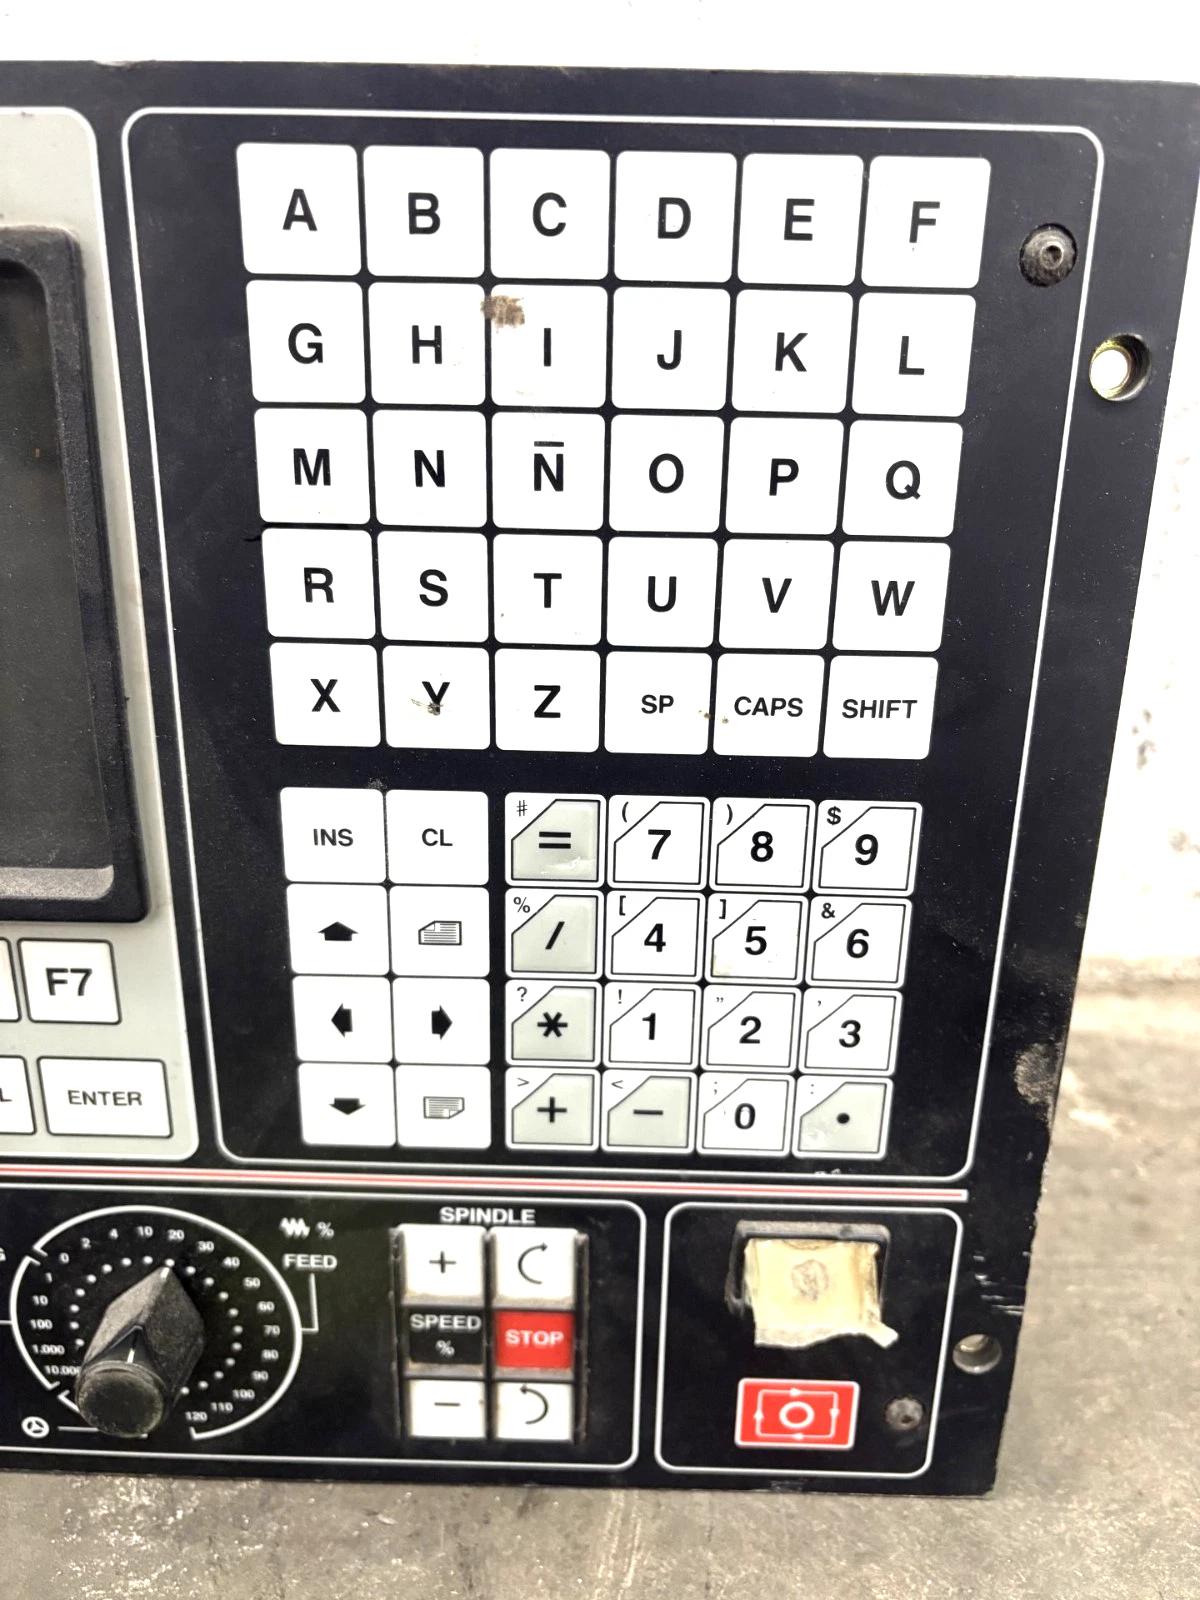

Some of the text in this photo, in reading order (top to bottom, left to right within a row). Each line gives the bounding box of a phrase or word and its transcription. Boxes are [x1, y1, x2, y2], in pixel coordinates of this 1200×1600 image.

[282, 189, 318, 231] A
[409, 192, 441, 235] B
[532, 192, 568, 237] C
[658, 198, 691, 239] D
[784, 199, 814, 241] E
[909, 202, 940, 243] F
[288, 323, 324, 364] G
[412, 326, 442, 364] H
[544, 329, 551, 366] I
[657, 330, 682, 370] J
[776, 333, 807, 372] K
[899, 337, 924, 375] L
[293, 449, 331, 486] M
[415, 450, 445, 488] N
[649, 454, 684, 494] O
[770, 459, 799, 496] P
[886, 461, 921, 499] Q
[304, 568, 334, 602] R
[419, 570, 448, 606] S
[534, 573, 561, 608] T
[648, 576, 677, 612] U
[762, 579, 792, 614] V
[872, 581, 914, 616] W
[311, 680, 340, 712] X
[423, 682, 451, 715] Y
[534, 685, 561, 718] Z
[641, 694, 674, 713] SP
[734, 696, 803, 718] CAPS
[842, 699, 918, 719] SHIFT
[516, 801, 528, 816] #
[621, 801, 629, 822] (
[726, 804, 733, 825] )
[826, 806, 841, 825] $
[313, 829, 353, 846] INS
[422, 829, 452, 847] CL
[648, 829, 671, 859] 7
[750, 831, 774, 862] 8
[855, 834, 878, 865] 9
[514, 897, 530, 913] %
[619, 895, 626, 915] [
[719, 899, 726, 919] ]
[821, 903, 835, 918] &
[545, 921, 564, 949] /
[644, 924, 666, 952] 4
[745, 926, 767, 955] 5
[846, 929, 869, 958] 6
[45, 967, 93, 997] F7
[517, 986, 527, 1002] ?
[618, 989, 622, 1004] !
[642, 1013, 656, 1040] 1
[739, 1016, 760, 1044] 2
[839, 1020, 861, 1048] 3
[67, 1090, 142, 1107] ENTER
[735, 1103, 755, 1129] 0
[440, 1206, 536, 1224] SPINDLE
[109, 1229, 118, 1240] 4
[137, 1226, 153, 1238] 10
[168, 1229, 185, 1240] 20
[316, 1221, 335, 1238] %
[81, 1238, 91, 1249] 2
[198, 1240, 215, 1252] 30
[60, 1253, 69, 1264] 0
[223, 1256, 240, 1268] 40
[283, 1254, 337, 1271] FEED
[243, 1277, 261, 1289] 50
[32, 1295, 48, 1306] 10
[257, 1301, 274, 1312] 60
[30, 1319, 52, 1330] 100
[263, 1325, 280, 1336] 70
[411, 1314, 482, 1331] SPEED
[436, 1340, 454, 1356] %
[505, 1330, 564, 1346] STOP
[262, 1349, 279, 1361] 80
[252, 1370, 269, 1382] 90
[233, 1389, 255, 1400] 100
[185, 1411, 208, 1422] 120
[211, 1402, 233, 1413] 110
